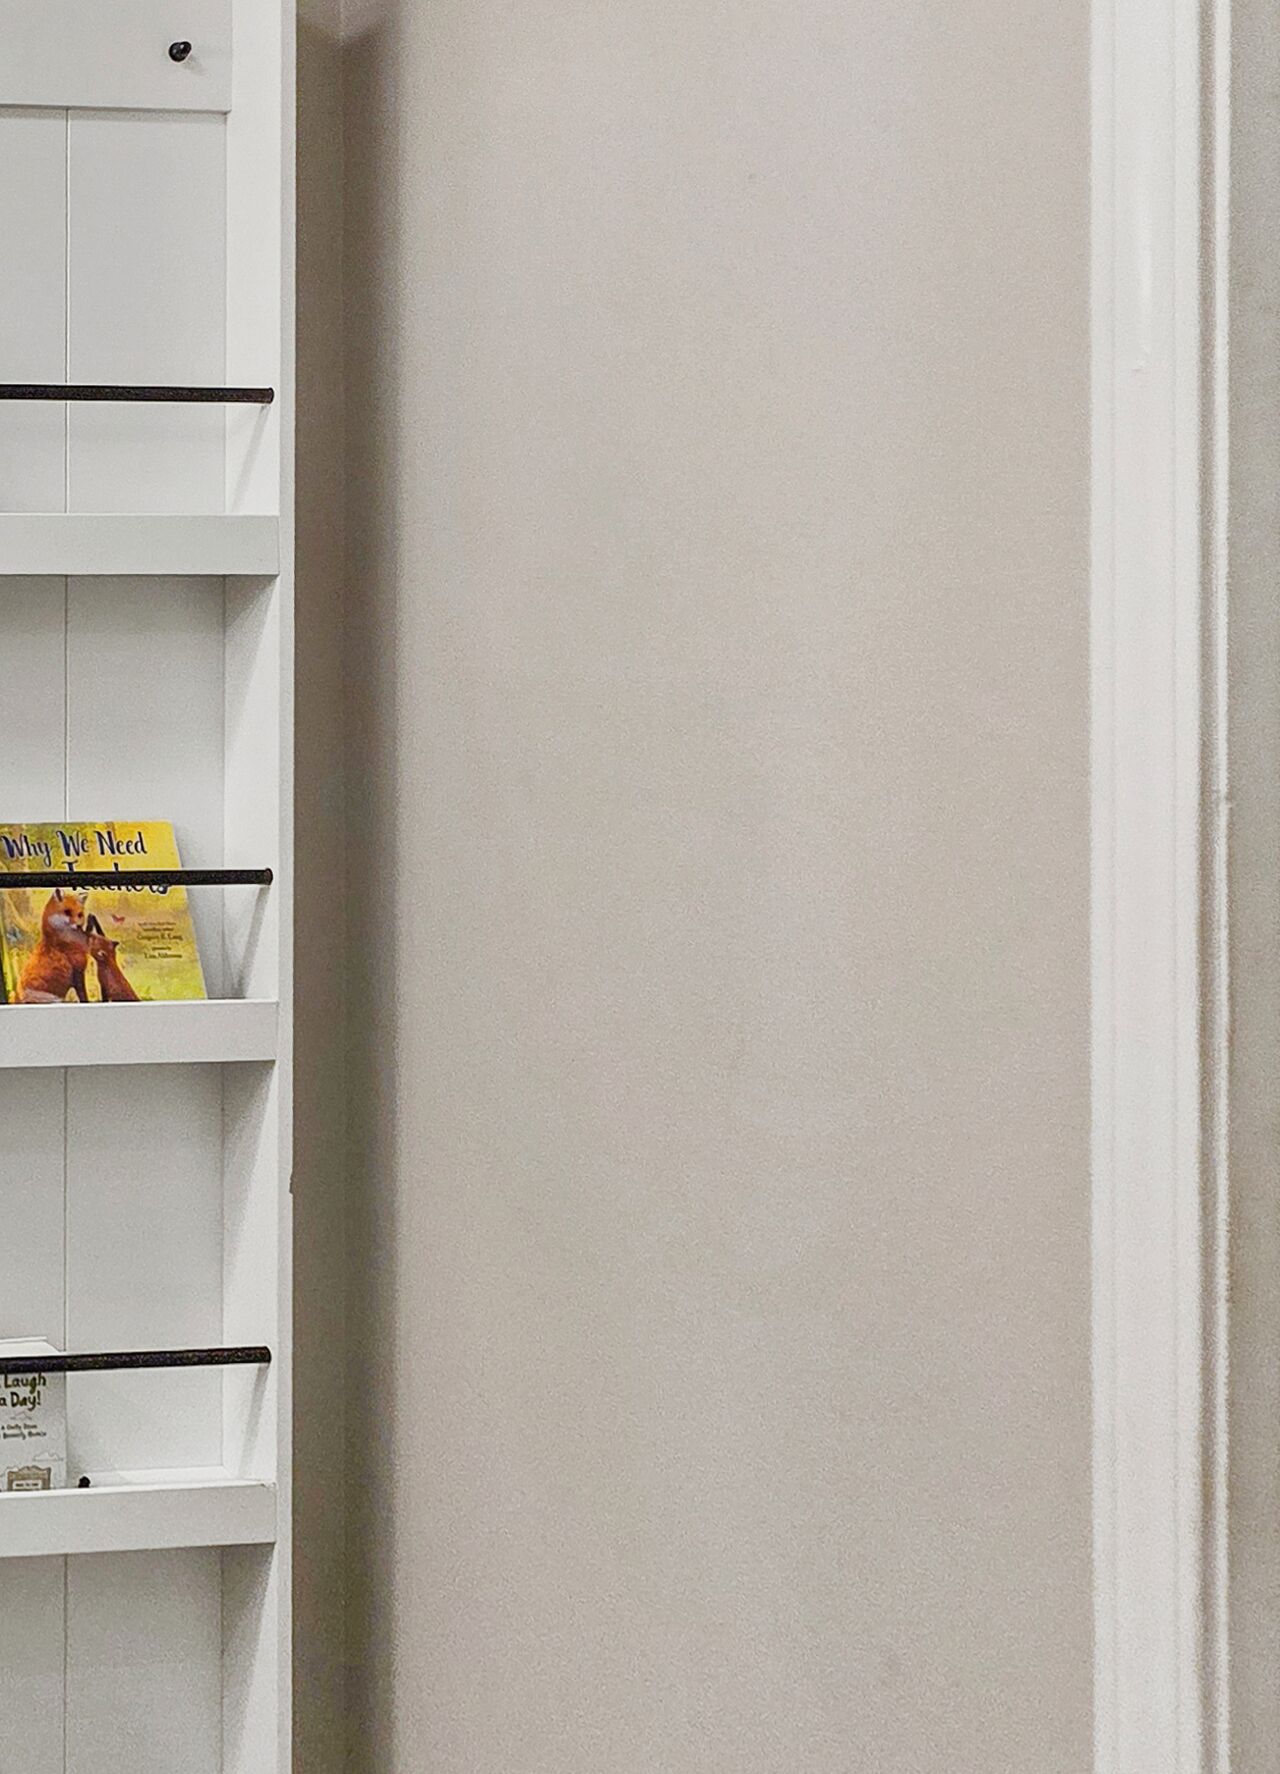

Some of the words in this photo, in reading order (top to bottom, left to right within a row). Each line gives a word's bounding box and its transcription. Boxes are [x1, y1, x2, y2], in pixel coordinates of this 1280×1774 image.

[1, 834, 52, 867] Why
[56, 830, 89, 857] We
[95, 830, 147, 855] Need
[4, 1371, 47, 1394] Laugh
[10, 1390, 42, 1412] Day!
